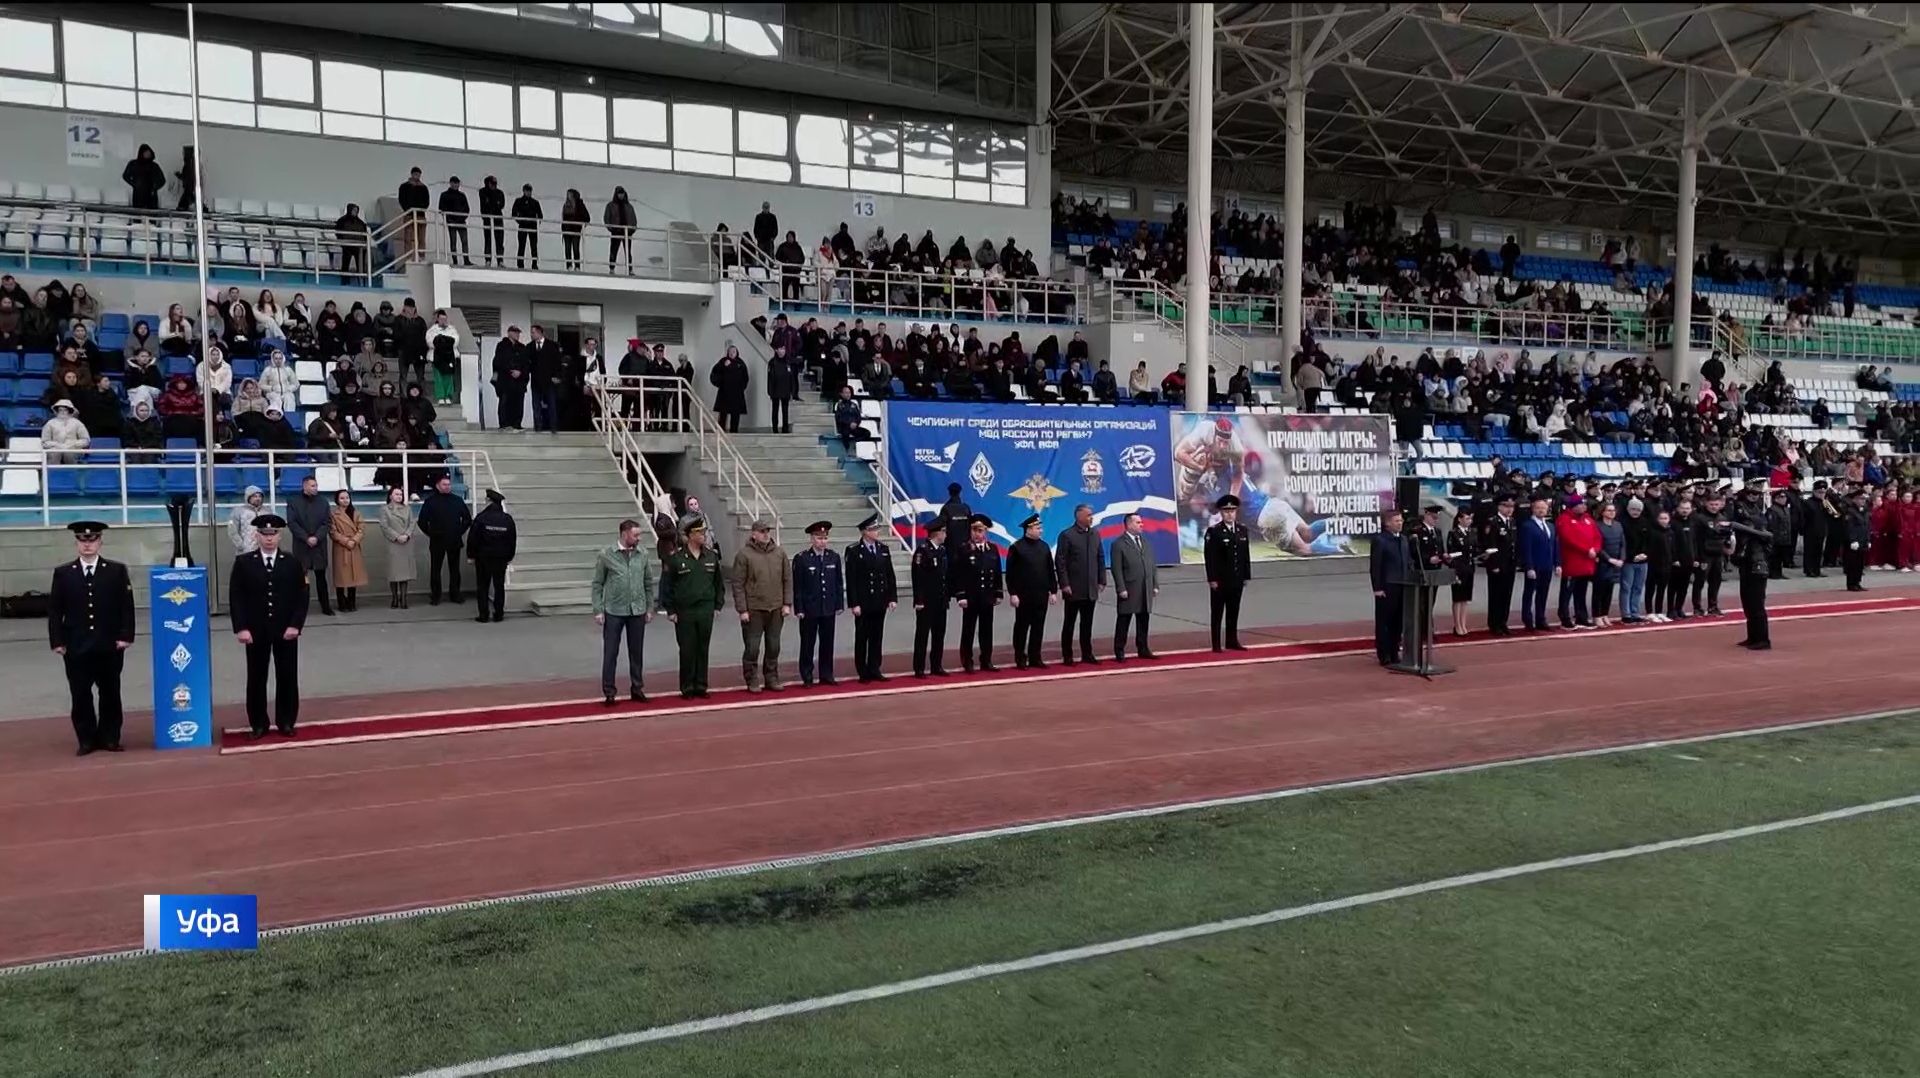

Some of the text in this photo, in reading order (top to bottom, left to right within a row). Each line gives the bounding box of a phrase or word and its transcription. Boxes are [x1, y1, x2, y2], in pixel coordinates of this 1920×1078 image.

[68, 125, 101, 144] 12
[854, 201, 874, 216] 13
[1226, 199, 1238, 209] 14
[907, 416, 1157, 431] ЧЕМПИОНАТ СРЕДИ ОБРАЗОВАТЕЛЬНЫХ ОРГАНИЗАЦИЙ
[978, 429, 1093, 440] МВД РОССИИ ПО РЕГБИ-7
[1267, 431, 1378, 450] ПРИНЦИПЫ ИГРЫ:
[914, 454, 942, 462] РОССИИ
[1291, 453, 1378, 473] ЦЕЛОСТНОСТЬ!
[1283, 475, 1378, 494] СОЛИДАРНОСТЬ!
[1313, 495, 1380, 514] УВАЖЕНИЕ!
[1325, 516, 1382, 535] СТРАСТЬ!
